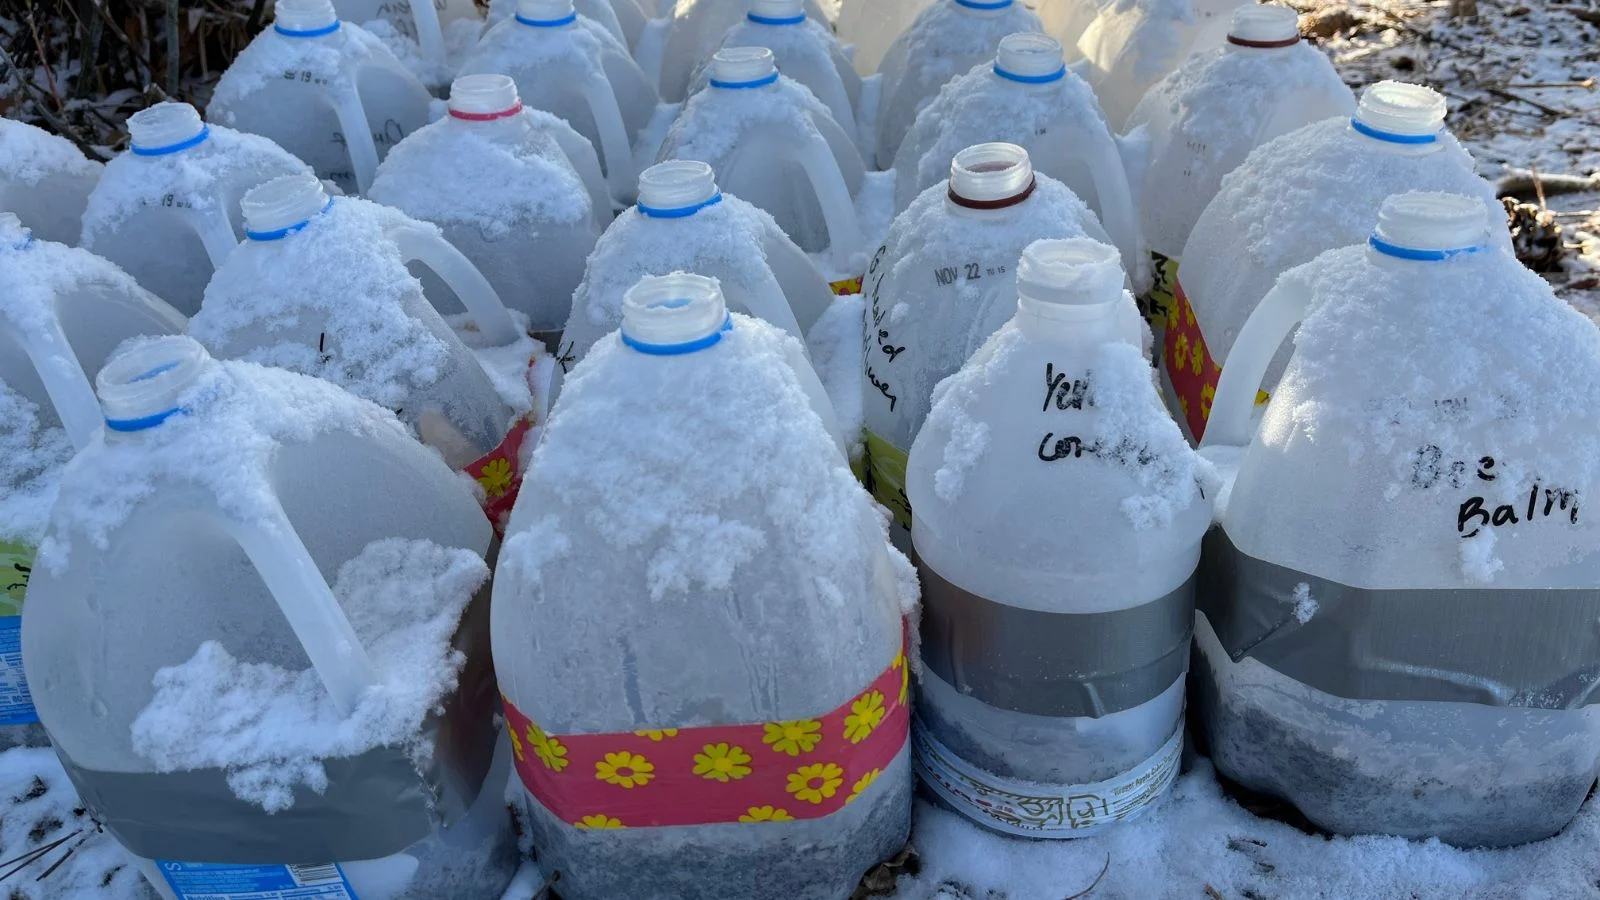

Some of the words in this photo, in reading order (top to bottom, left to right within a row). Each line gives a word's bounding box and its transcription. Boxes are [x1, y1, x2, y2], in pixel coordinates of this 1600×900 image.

[934, 266, 958, 287] NOV
[963, 262, 981, 280] 22
[1457, 487, 1581, 538] Balm
